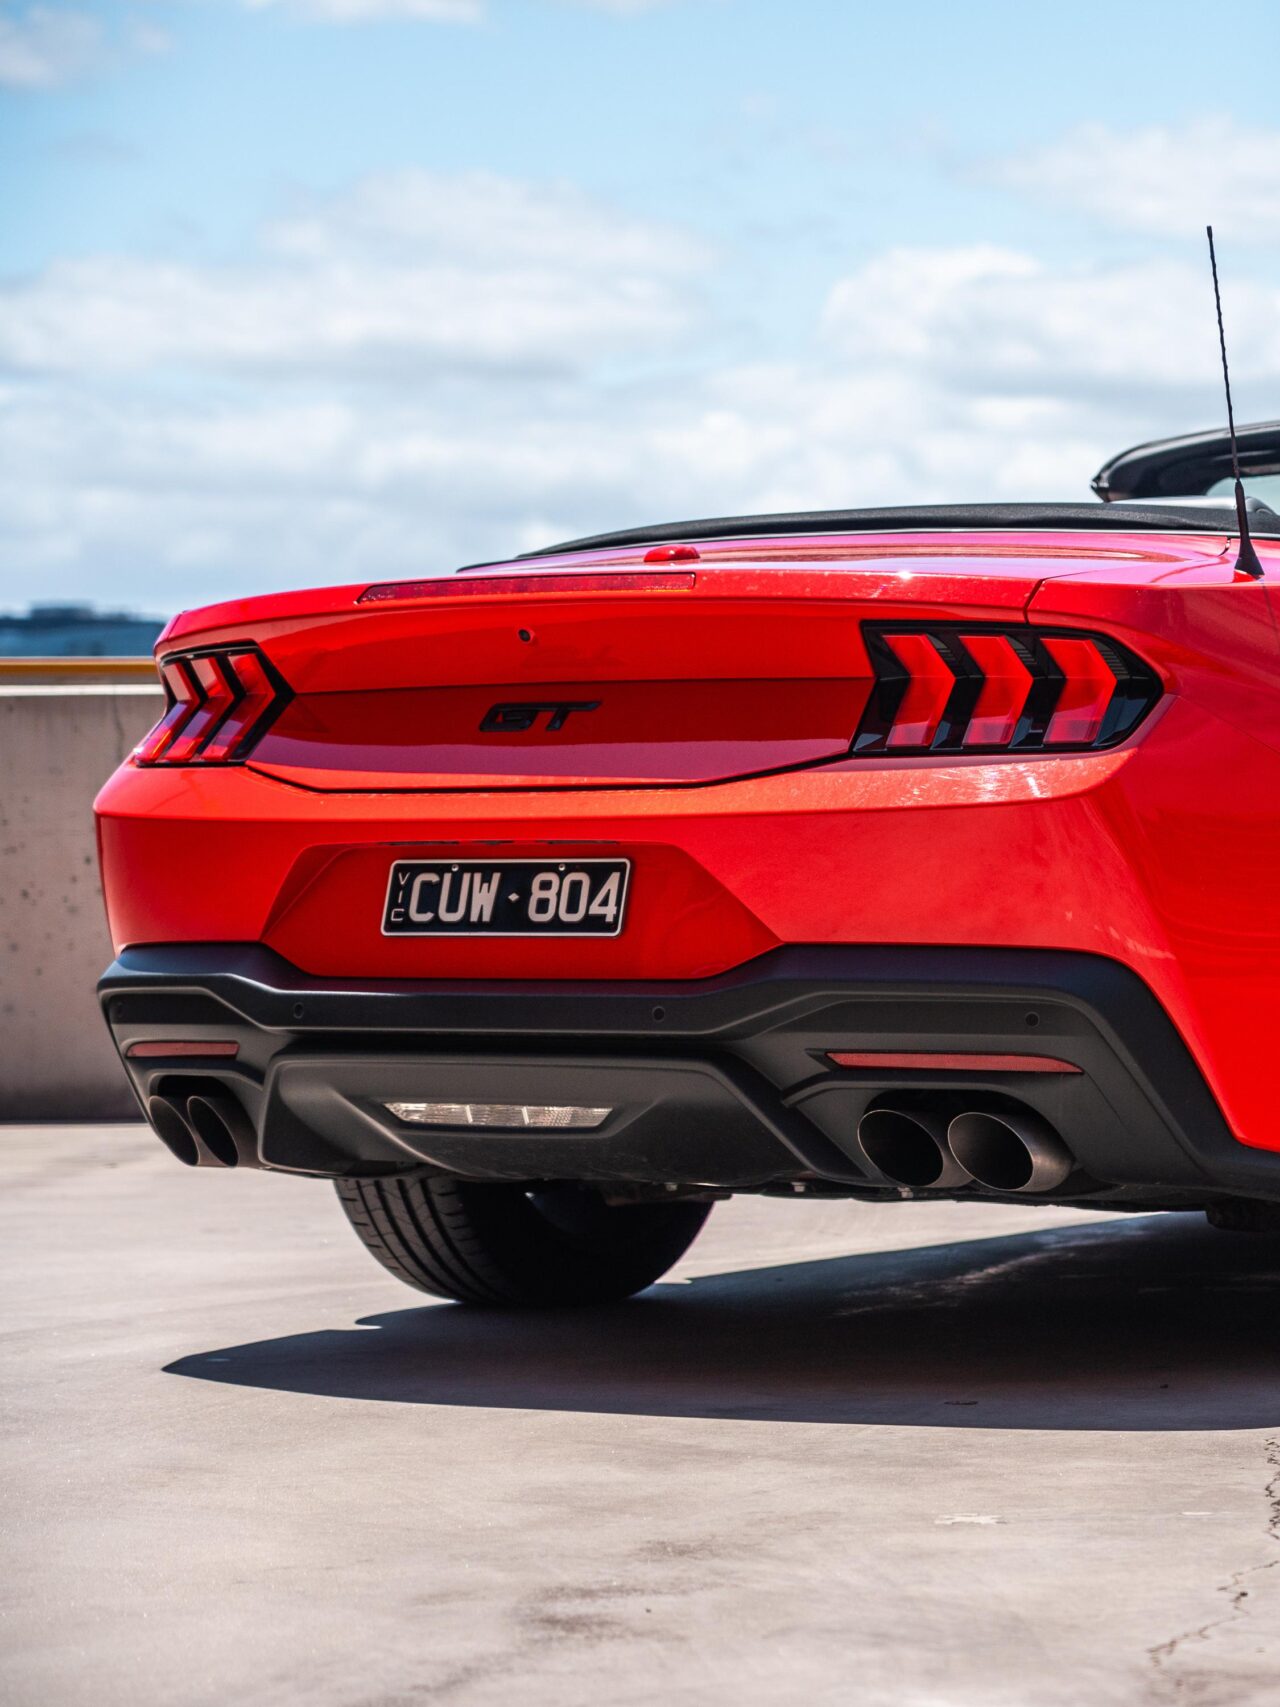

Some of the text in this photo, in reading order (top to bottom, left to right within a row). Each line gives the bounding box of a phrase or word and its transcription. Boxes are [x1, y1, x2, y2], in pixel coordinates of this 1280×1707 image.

[479, 702, 602, 731] GT
[391, 872, 410, 921] VIC
[409, 872, 621, 923] CUW 804
